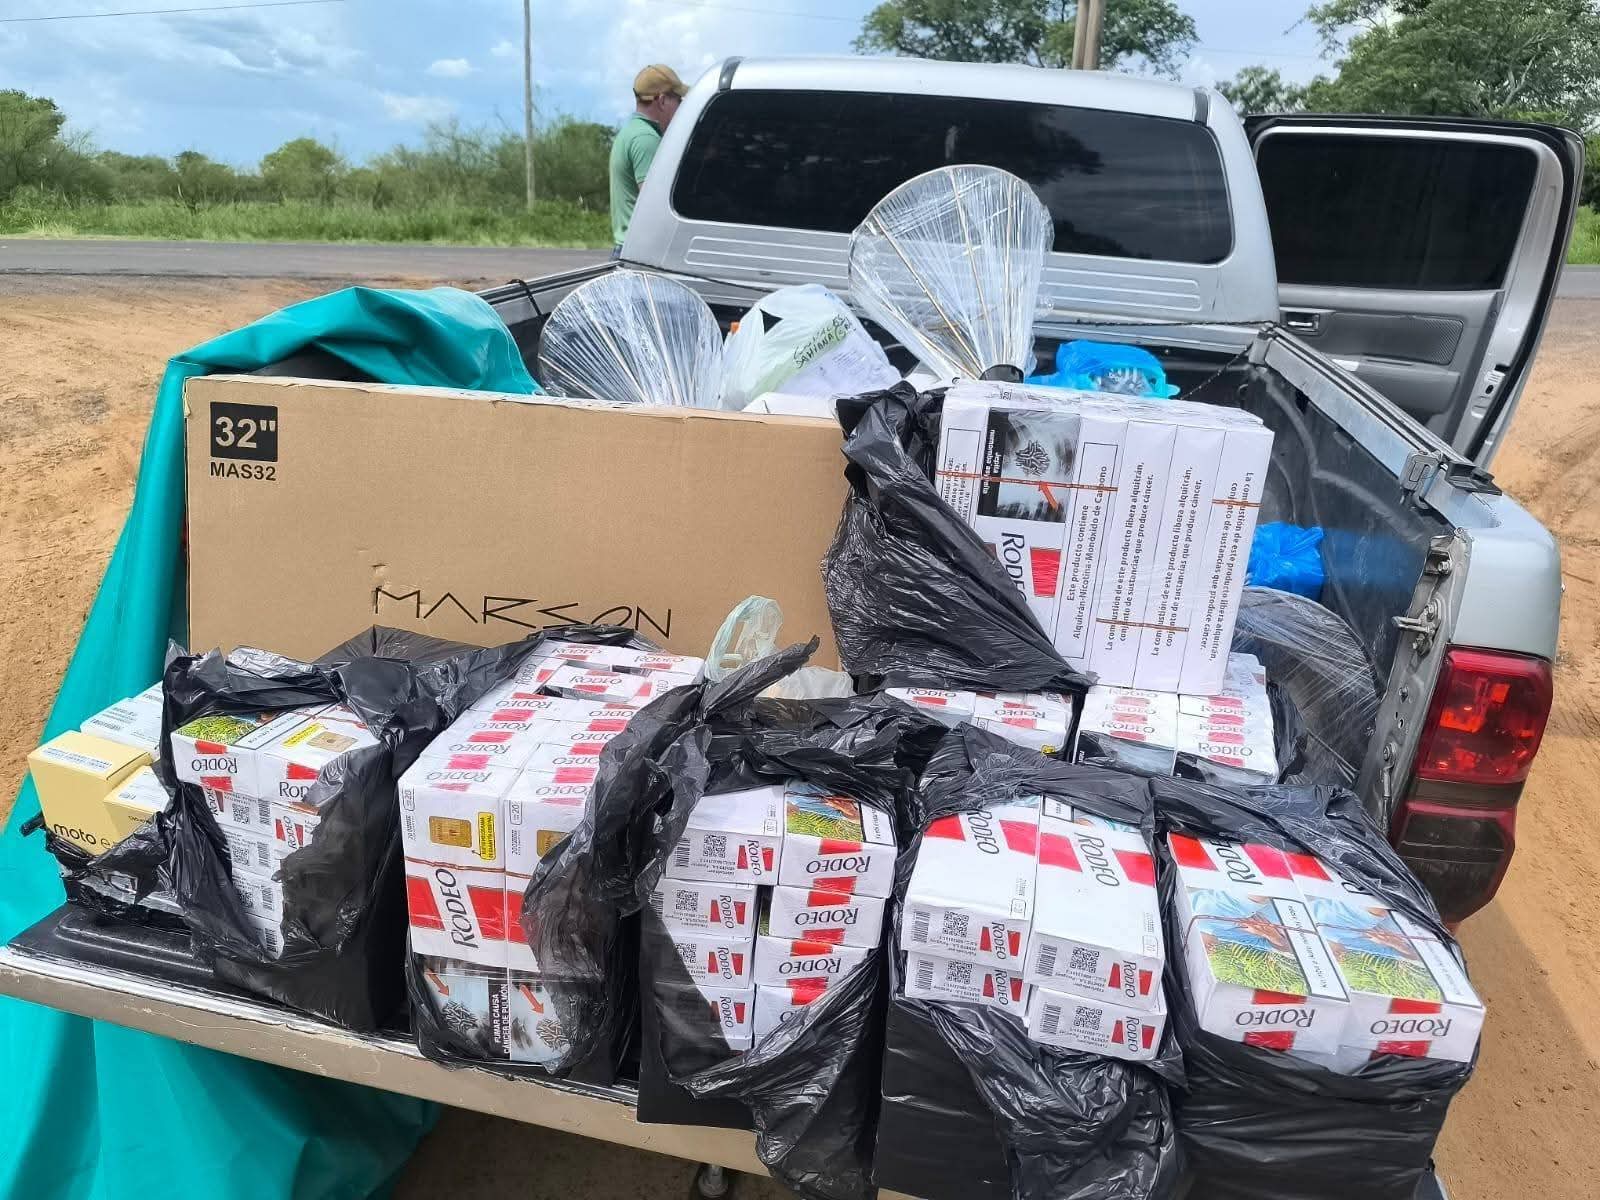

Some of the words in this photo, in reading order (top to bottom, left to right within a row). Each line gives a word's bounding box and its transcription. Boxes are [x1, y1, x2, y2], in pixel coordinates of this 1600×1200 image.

[214, 415, 277, 450] 32"
[210, 462, 277, 482] MAS32
[1130, 461, 1144, 503] alquitrán,
[1245, 471, 1253, 482] La
[1141, 473, 1153, 503] cáncer.
[1177, 466, 1192, 508] alquitrán,
[1190, 478, 1202, 508] cáncer.
[1092, 504, 1100, 516] de
[1224, 482, 1239, 519] conjnto
[1234, 483, 1251, 532] comustión
[1076, 504, 1088, 541] contiene
[1125, 503, 1136, 528] libera
[1136, 504, 1149, 537] produce
[1172, 508, 1183, 532] libera
[1184, 509, 1197, 542] produce
[1223, 520, 1231, 530] de
[1119, 529, 1133, 565] producto
[1134, 538, 1143, 553] que
[1232, 532, 1241, 543] de
[1166, 534, 1180, 570] producto
[1181, 543, 1191, 558] que
[1214, 531, 1229, 574] sustancias
[1228, 544, 1238, 561] este
[1070, 543, 1084, 582] producto
[1116, 566, 1126, 583] este
[1126, 554, 1140, 595] sustancias
[1164, 571, 1172, 587] este
[1173, 559, 1187, 600] sustancias
[1209, 574, 1219, 589] que
[1219, 562, 1234, 598] producto
[1066, 583, 1076, 601] Este
[1114, 584, 1122, 594] de
[1161, 589, 1169, 599] de
[1124, 596, 1132, 606] de
[1170, 601, 1179, 611] de
[1203, 590, 1217, 622] produce
[1216, 599, 1227, 622] libera
[374, 586, 672, 639] MARSON
[1106, 595, 1121, 640] comustión
[1153, 599, 1167, 646] comustión
[1119, 607, 1132, 641] conjnto
[1165, 613, 1178, 647] conjnto
[1105, 641, 1113, 650] La
[1151, 646, 1159, 655] La
[634, 655, 685, 663] RODEO
[569, 675, 622, 685] RODEO
[905, 687, 957, 698] RODEO
[495, 700, 553, 709] RODEO
[589, 710, 634, 718] ODEO
[994, 708, 1046, 719] RODEO
[1105, 704, 1157, 715] RODEO
[1201, 705, 1251, 716] RODEO
[474, 722, 533, 731] RODEO
[570, 733, 615, 741] ODEO
[1102, 720, 1155, 734] RODEO
[450, 743, 511, 754] RODEO
[1198, 742, 1253, 757] RODEO
[191, 757, 238, 773] RODEO
[552, 757, 599, 765] ODEO
[426, 771, 493, 783] RODEO
[279, 781, 310, 799] ROD
[54, 823, 97, 845] moto
[283, 814, 297, 850] RODEO
[967, 811, 1000, 855] RODEO
[747, 839, 762, 876] RODEO
[805, 855, 871, 874] RODEO
[1075, 832, 1120, 887] RODEO
[435, 868, 479, 949] RODEO
[720, 894, 734, 929] RODEO
[795, 907, 858, 926] RODEO
[991, 921, 1007, 960] RODEO
[717, 946, 733, 980] RODEO
[779, 957, 842, 975] RODEO
[995, 968, 1009, 1005] RODEO
[1122, 959, 1137, 998] RODEO
[492, 993, 500, 1018] CAUSA
[720, 996, 734, 1028] RODEO
[502, 1014, 510, 1025] DE
[1235, 1008, 1316, 1028] RODEO
[1369, 1018, 1452, 1037] RODEO
[493, 1019, 501, 1044] FUMAR
[1125, 1016, 1140, 1052] RODEO
